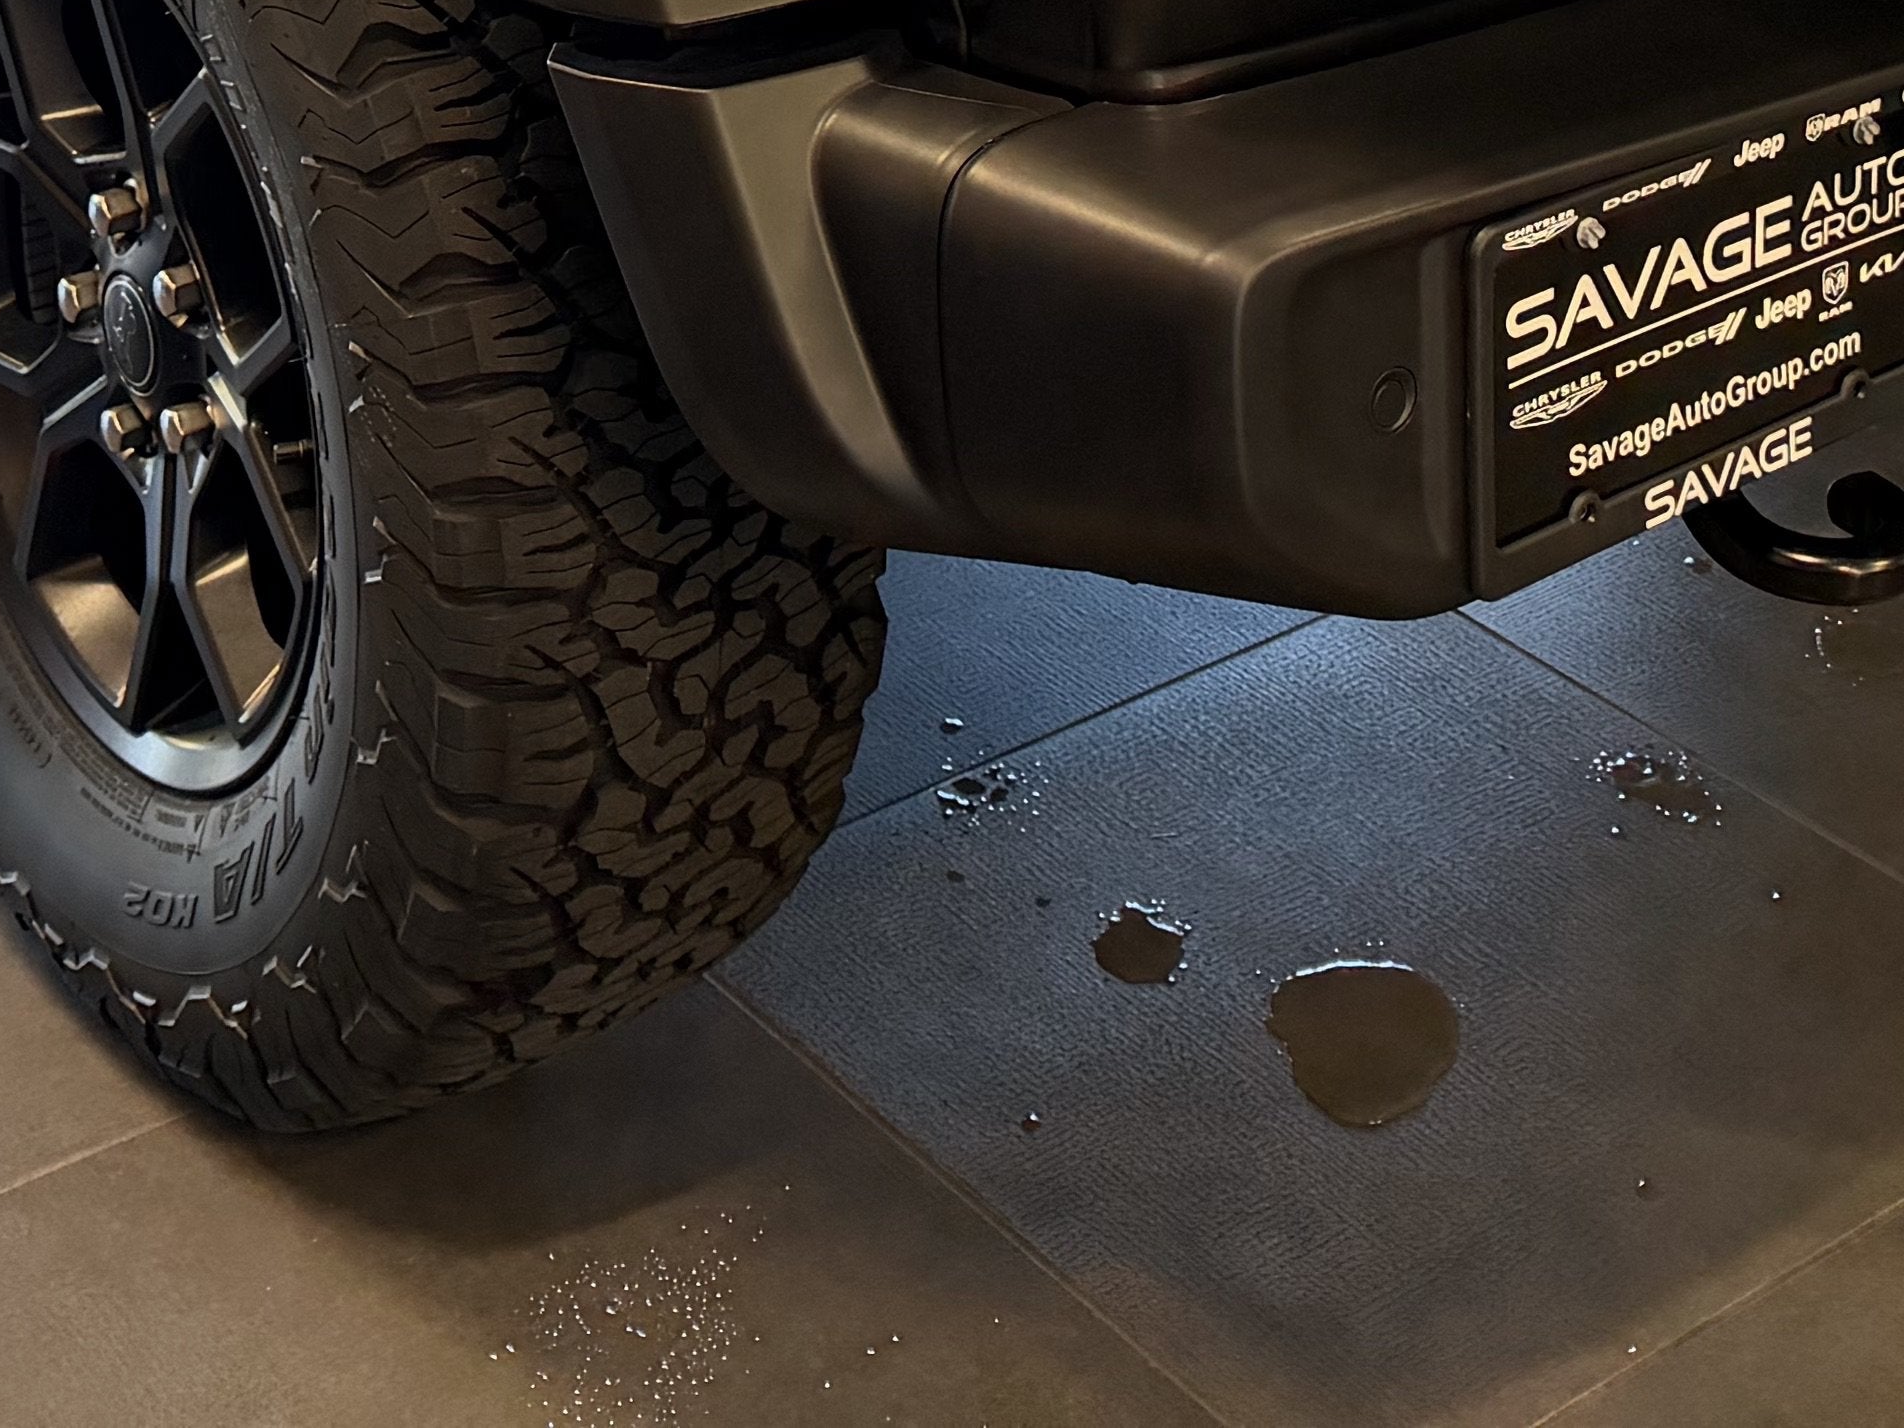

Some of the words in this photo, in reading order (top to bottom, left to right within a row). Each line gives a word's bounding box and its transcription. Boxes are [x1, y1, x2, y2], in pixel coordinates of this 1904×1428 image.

[1504, 209, 1576, 242] CHRYSLER
[1603, 168, 1698, 212] DODGE
[1733, 133, 1786, 167] Jeep
[1824, 97, 1883, 132] RAM
[1505, 196, 1793, 370] SAVAGE
[1512, 370, 1603, 418] CHRYSLER
[1615, 321, 1730, 379] DODGE
[1755, 287, 1812, 329] Jeep
[1818, 301, 1853, 321] RAM
[1568, 330, 1862, 477] SavageAutoGroup.com
[1645, 417, 1814, 529] SAVAGE
[122, 882, 199, 929] KO2
